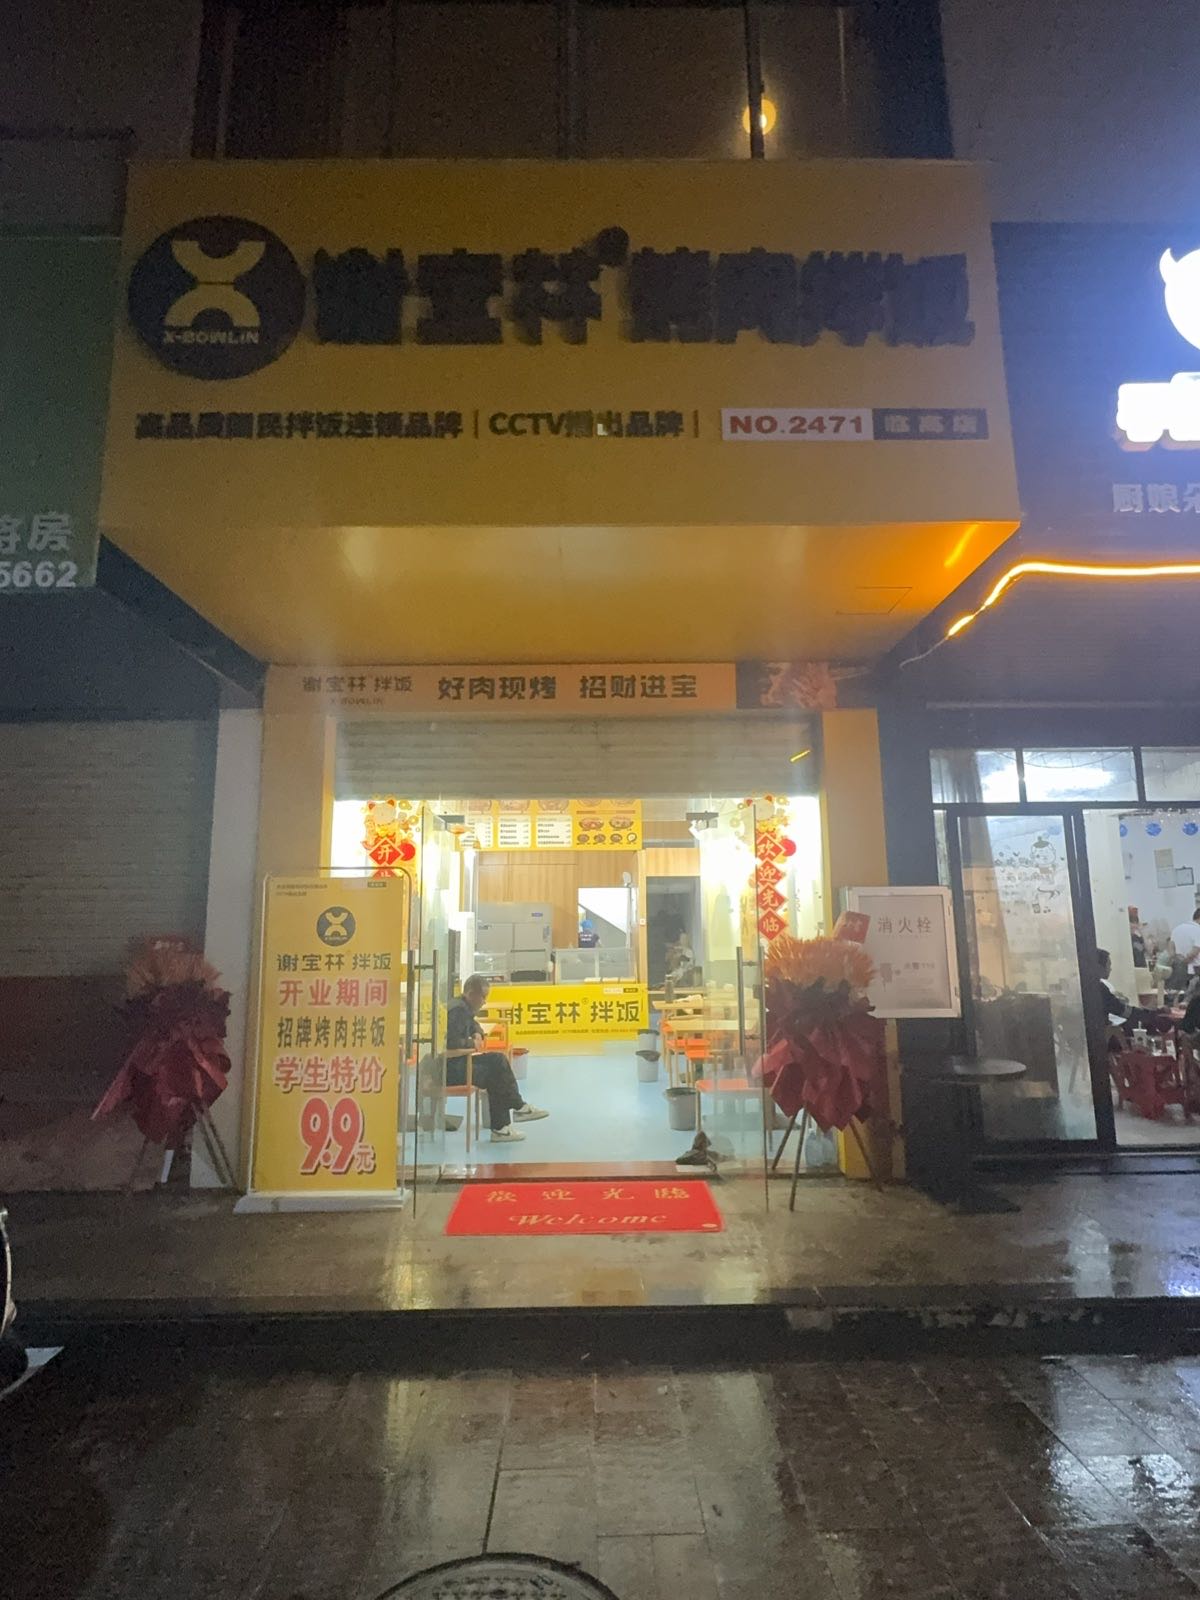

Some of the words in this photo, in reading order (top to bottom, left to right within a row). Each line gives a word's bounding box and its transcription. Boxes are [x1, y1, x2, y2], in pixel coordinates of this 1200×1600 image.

[730, 415, 863, 435] NO.2471
[438, 676, 557, 701] 好肉现烤
[580, 675, 698, 699] 招财进宝
[757, 840, 780, 933] 欢迎光临
[877, 915, 932, 934] 消火栓
[278, 978, 390, 1008] 开业期间
[277, 1016, 386, 1048] 招牌烤肉拌饭
[274, 1055, 386, 1093] 学生特价
[508, 1213, 667, 1226] Welcome
